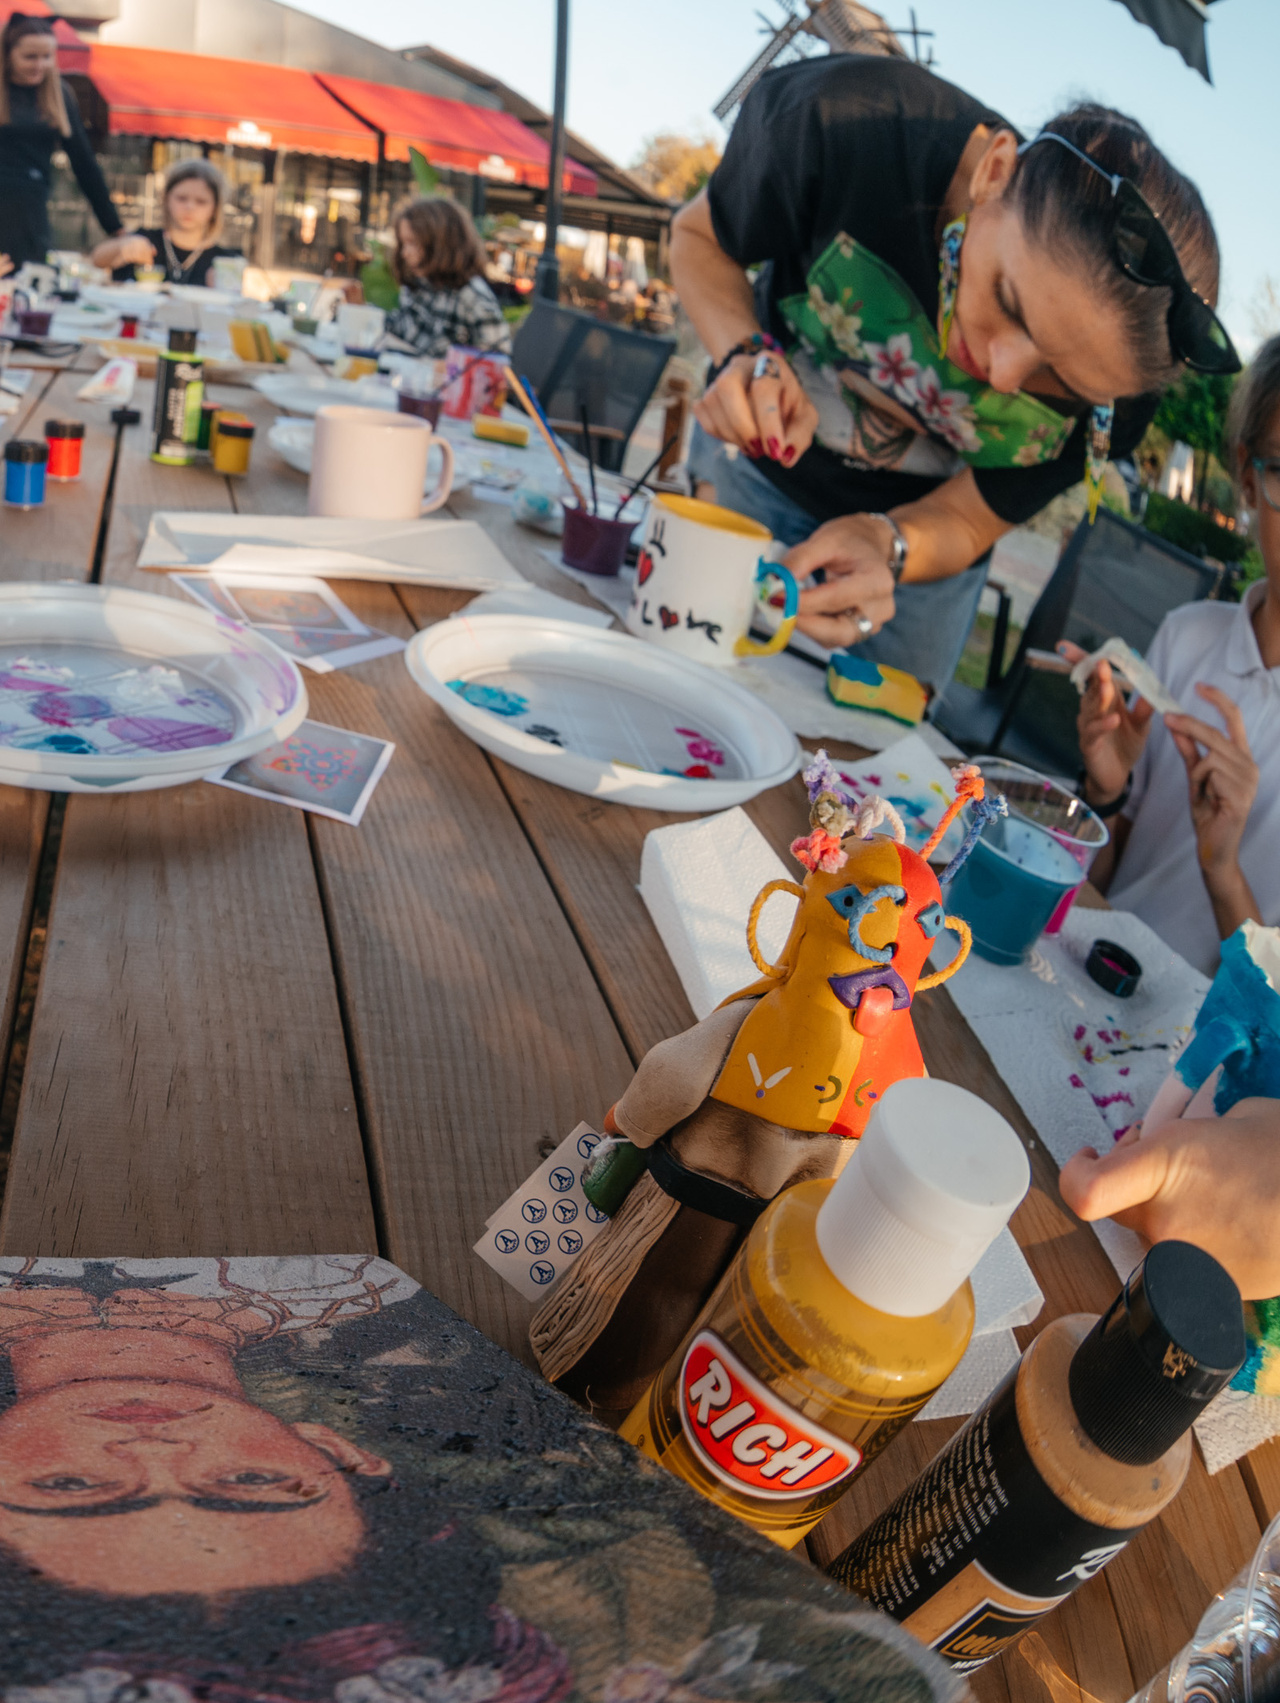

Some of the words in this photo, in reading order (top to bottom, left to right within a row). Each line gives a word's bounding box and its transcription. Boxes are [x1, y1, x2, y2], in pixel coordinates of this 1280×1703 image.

[688, 1358, 836, 1486] RICH
[982, 1443, 993, 1469] hobi
[976, 1464, 988, 1489] hobi
[970, 1490, 980, 1504] su
[938, 1532, 948, 1543] 2
[951, 1533, 964, 1550] bir
[919, 1541, 931, 1559] CE
[927, 1561, 937, 1575] ve
[942, 1541, 955, 1560] kat
[883, 1559, 903, 1604] decorative
[899, 1548, 913, 1575] paints
[908, 1574, 920, 1590] are
[885, 1598, 895, 1611] do
